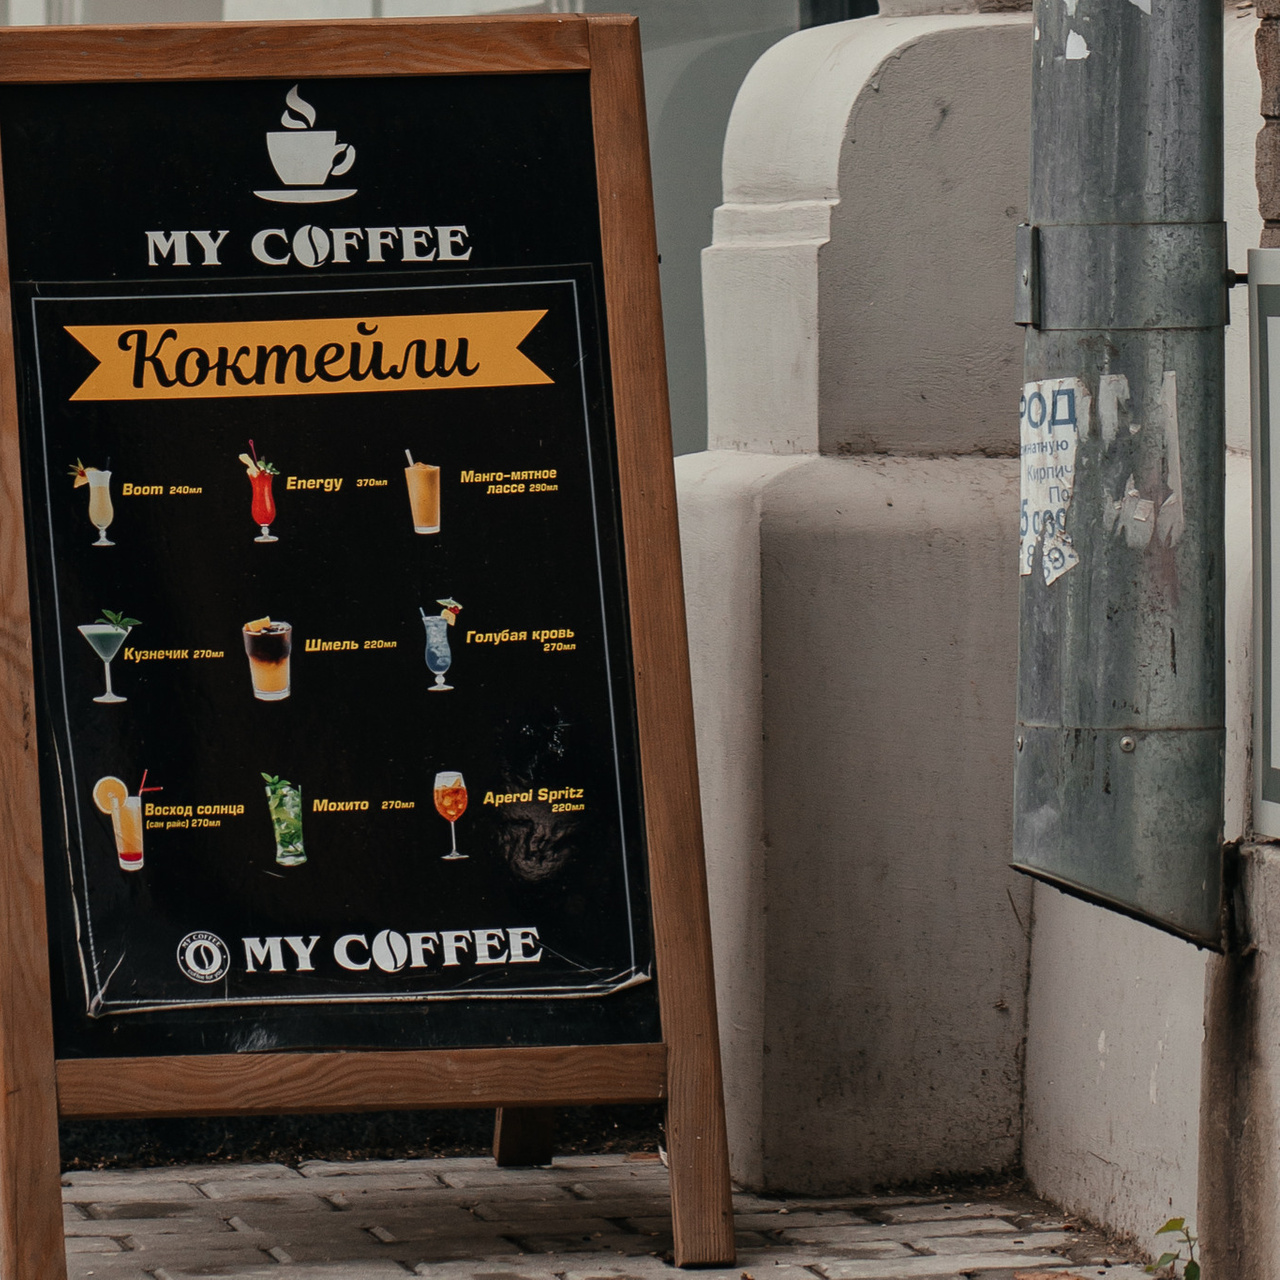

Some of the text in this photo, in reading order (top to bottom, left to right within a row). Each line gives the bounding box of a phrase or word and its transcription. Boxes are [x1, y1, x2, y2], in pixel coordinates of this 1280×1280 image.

[146, 225, 472, 267] MY COFFEE
[117, 322, 480, 389] Коктейли
[460, 470, 557, 483] Манго-мятное
[123, 483, 202, 495] Boom 240мл
[287, 477, 387, 492] Energy 370мл
[487, 483, 558, 494] лассе 290мл
[467, 628, 576, 645] Голубая кровь
[305, 639, 396, 652] Шмель 220мл
[543, 642, 577, 652] 270мл
[123, 648, 224, 662] Кузнечик 270мл
[483, 787, 584, 804] Aperol Spritz
[145, 803, 245, 817] Восход солнца
[313, 799, 414, 812] Мохито 270мл
[551, 802, 585, 812] 220мл
[146, 820, 164, 829] (сан
[191, 819, 220, 827] 270мл
[192, 933, 222, 947] COFFEE
[241, 928, 542, 972] MY COFFEE
